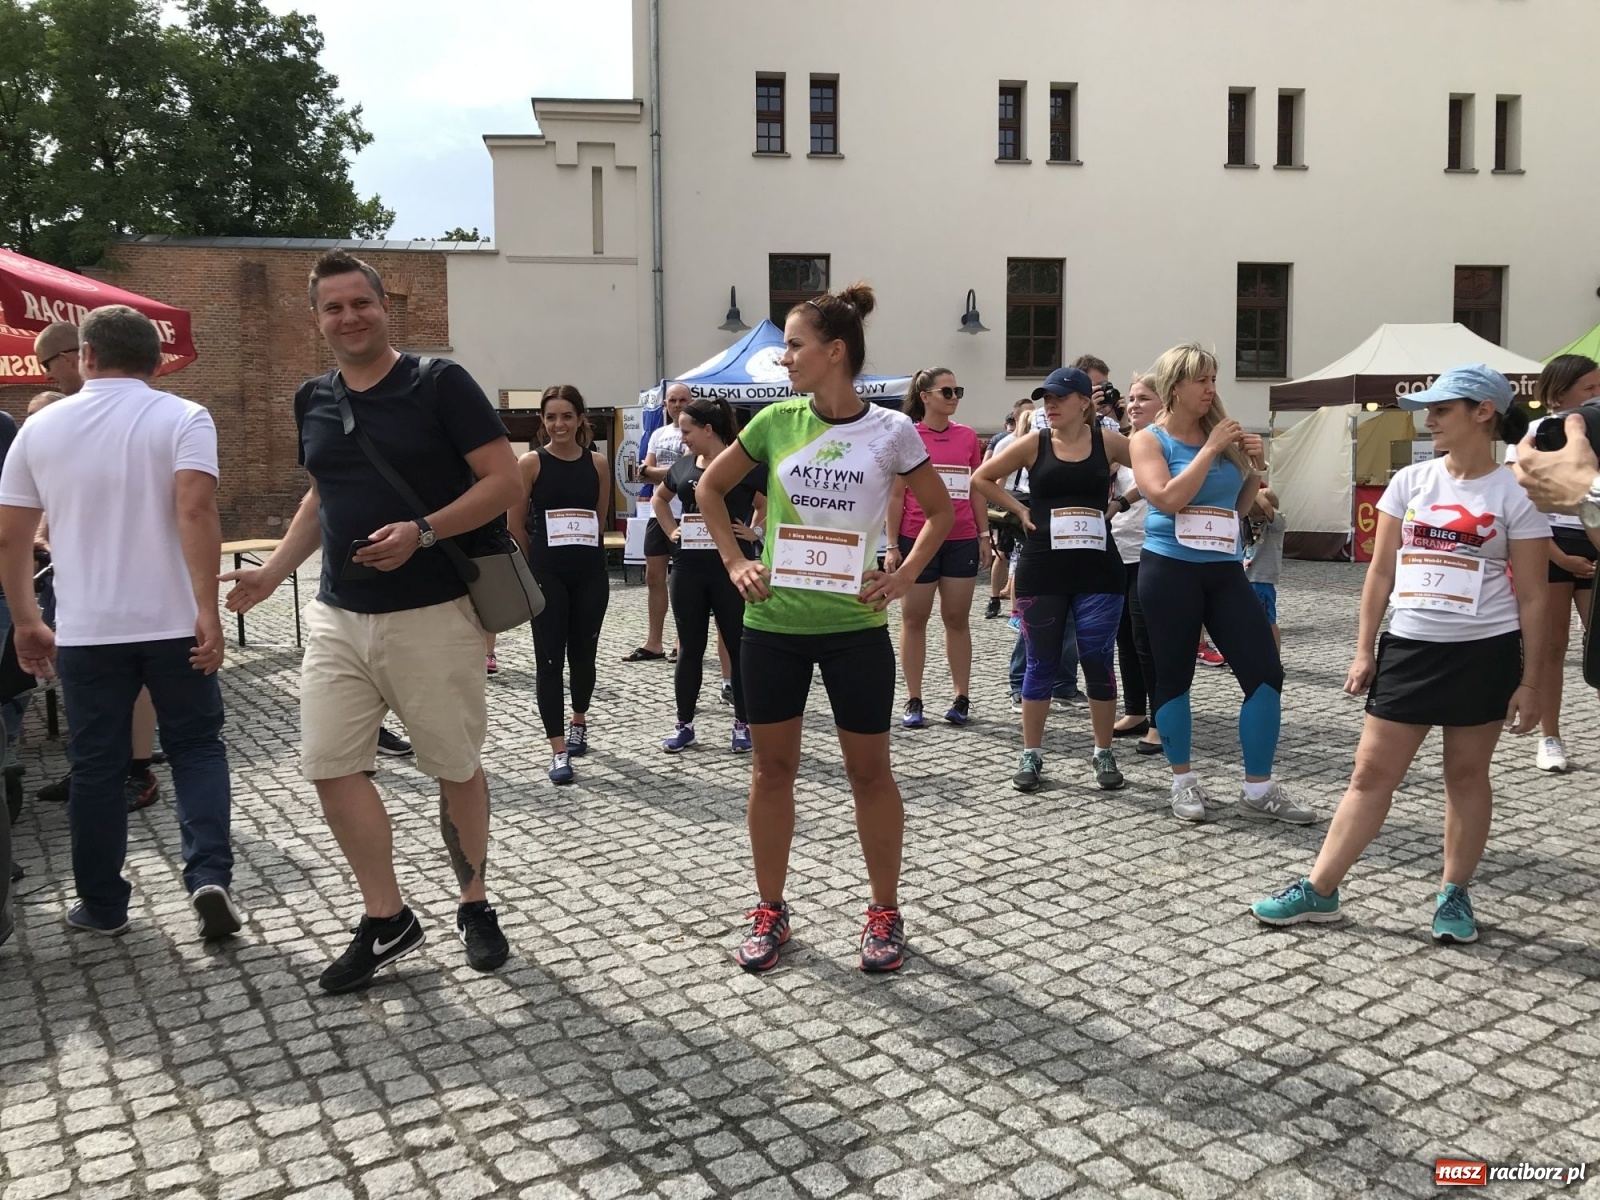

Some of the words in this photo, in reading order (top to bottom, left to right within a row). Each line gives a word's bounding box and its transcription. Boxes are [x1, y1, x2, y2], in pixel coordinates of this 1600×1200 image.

[746, 386, 808, 398] ODDZI
[789, 464, 864, 485] AKTYWNI
[805, 479, 848, 491] LYSKI
[790, 494, 856, 512] GEOFART
[567, 521, 580, 531] 42
[696, 526, 709, 537] 29
[1073, 520, 1088, 532] 32
[1204, 520, 1213, 532] 4
[1415, 527, 1426, 536] XI
[1429, 528, 1457, 541] BIEG
[1460, 533, 1483, 546] BEZ
[805, 549, 828, 566] 30
[1421, 572, 1445, 588] 37
